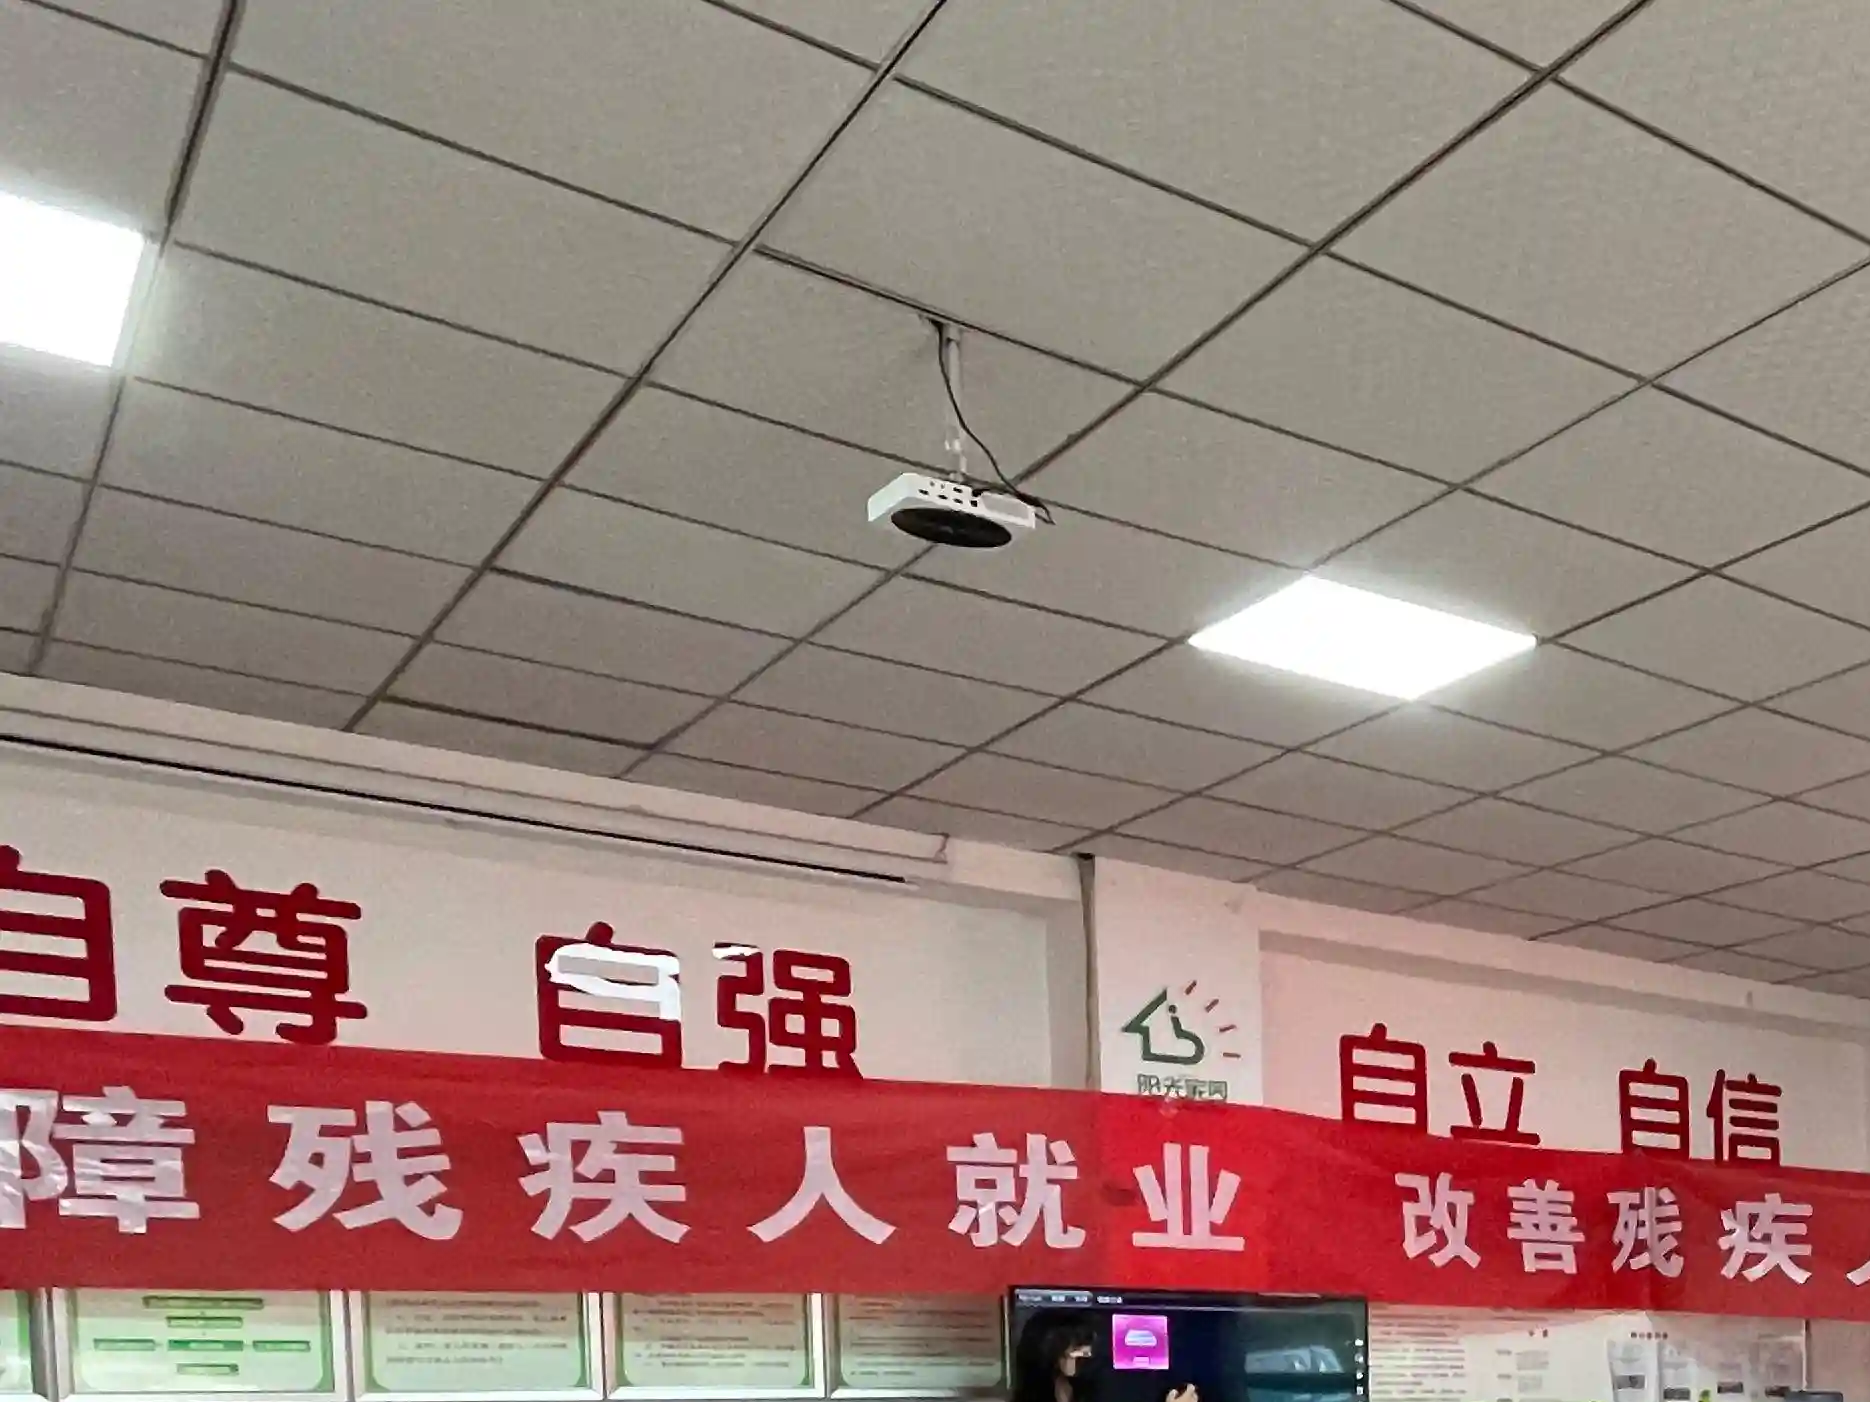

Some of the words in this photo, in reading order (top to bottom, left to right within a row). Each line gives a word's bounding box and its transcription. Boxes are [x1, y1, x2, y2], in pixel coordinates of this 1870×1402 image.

[0, 845, 368, 1045] 自尊
[536, 921, 863, 1079] 自强
[1340, 1022, 1541, 1146] 自立
[1619, 1058, 1784, 1166] 自信
